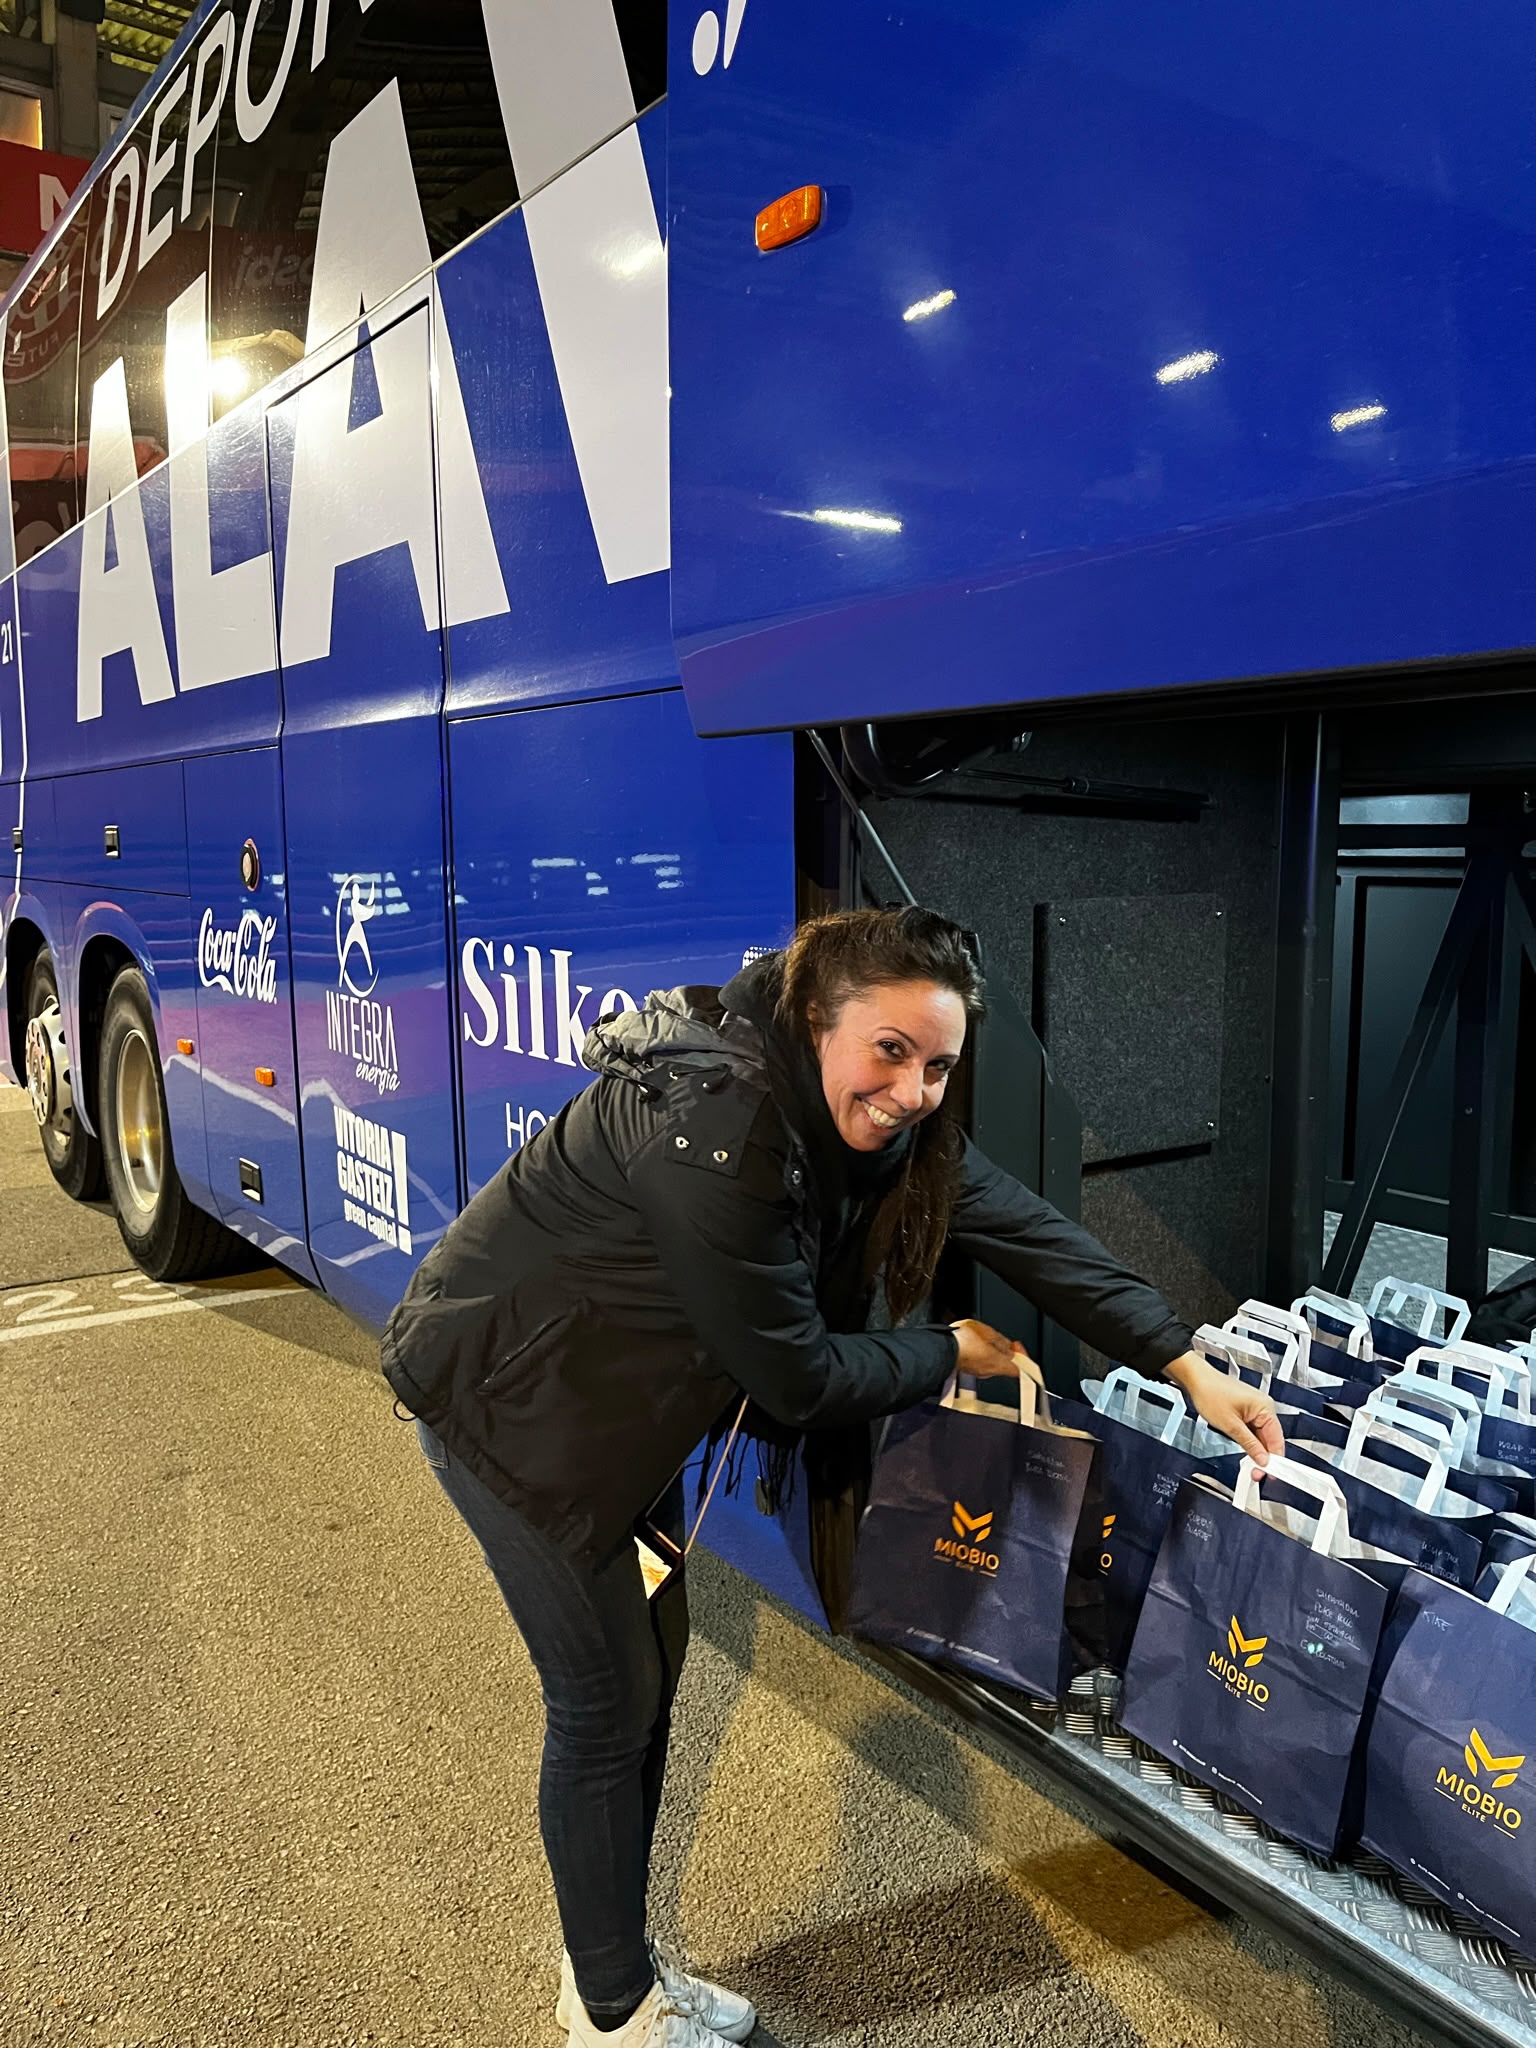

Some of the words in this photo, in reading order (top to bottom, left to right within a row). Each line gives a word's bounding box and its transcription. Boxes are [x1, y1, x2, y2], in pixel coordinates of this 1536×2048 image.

[199, 907, 278, 1005] Coca-Cola
[326, 990, 399, 1072] INTEGRA
[333, 1105, 392, 1172] VITORIA
[337, 1150, 395, 1219] GASTEIZ
[344, 1198, 367, 1230] green
[934, 1537, 1000, 1570] MIOBIO
[1208, 1651, 1270, 1703] MIOBIO
[1436, 1766, 1522, 1829] MIOBIO
[1461, 1803, 1486, 1823] ELITE
